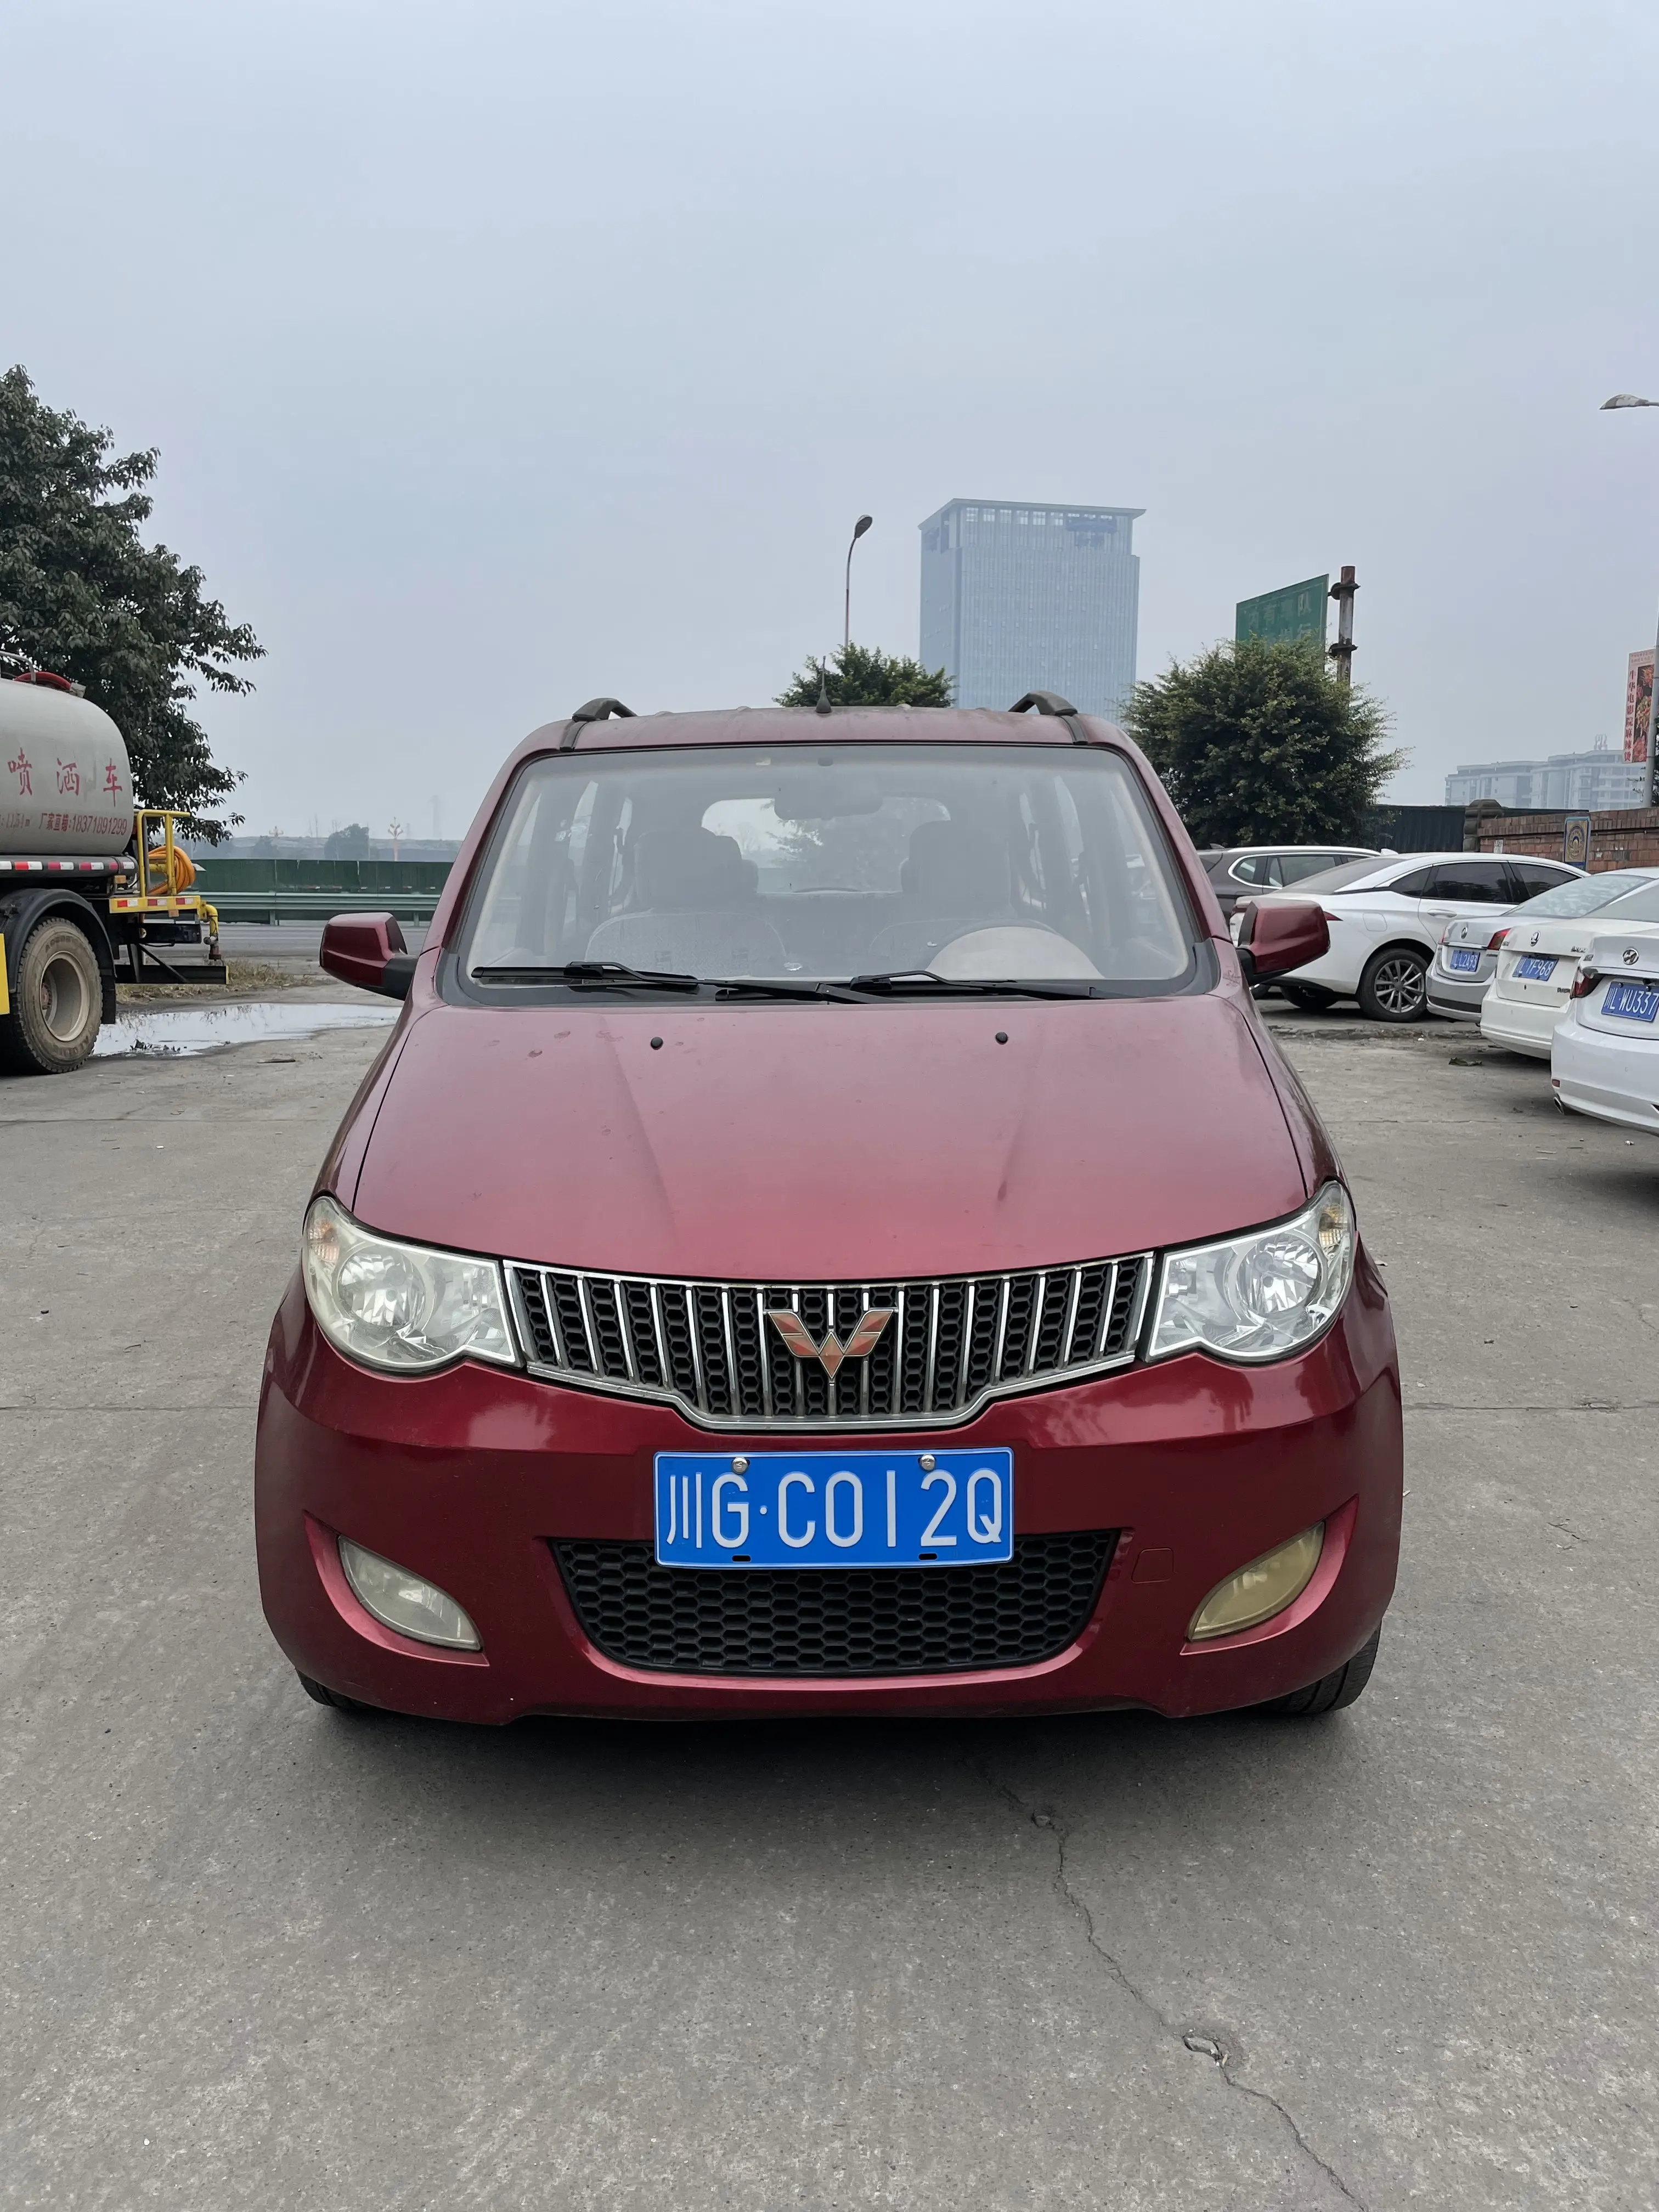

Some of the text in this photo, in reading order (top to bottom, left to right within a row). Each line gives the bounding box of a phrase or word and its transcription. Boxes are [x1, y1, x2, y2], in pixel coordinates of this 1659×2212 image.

[8, 747, 122, 807] 喷洒车
[1604, 988, 1659, 1015] 川L·WU337
[666, 1468, 1002, 1549] 川G·C012Q
